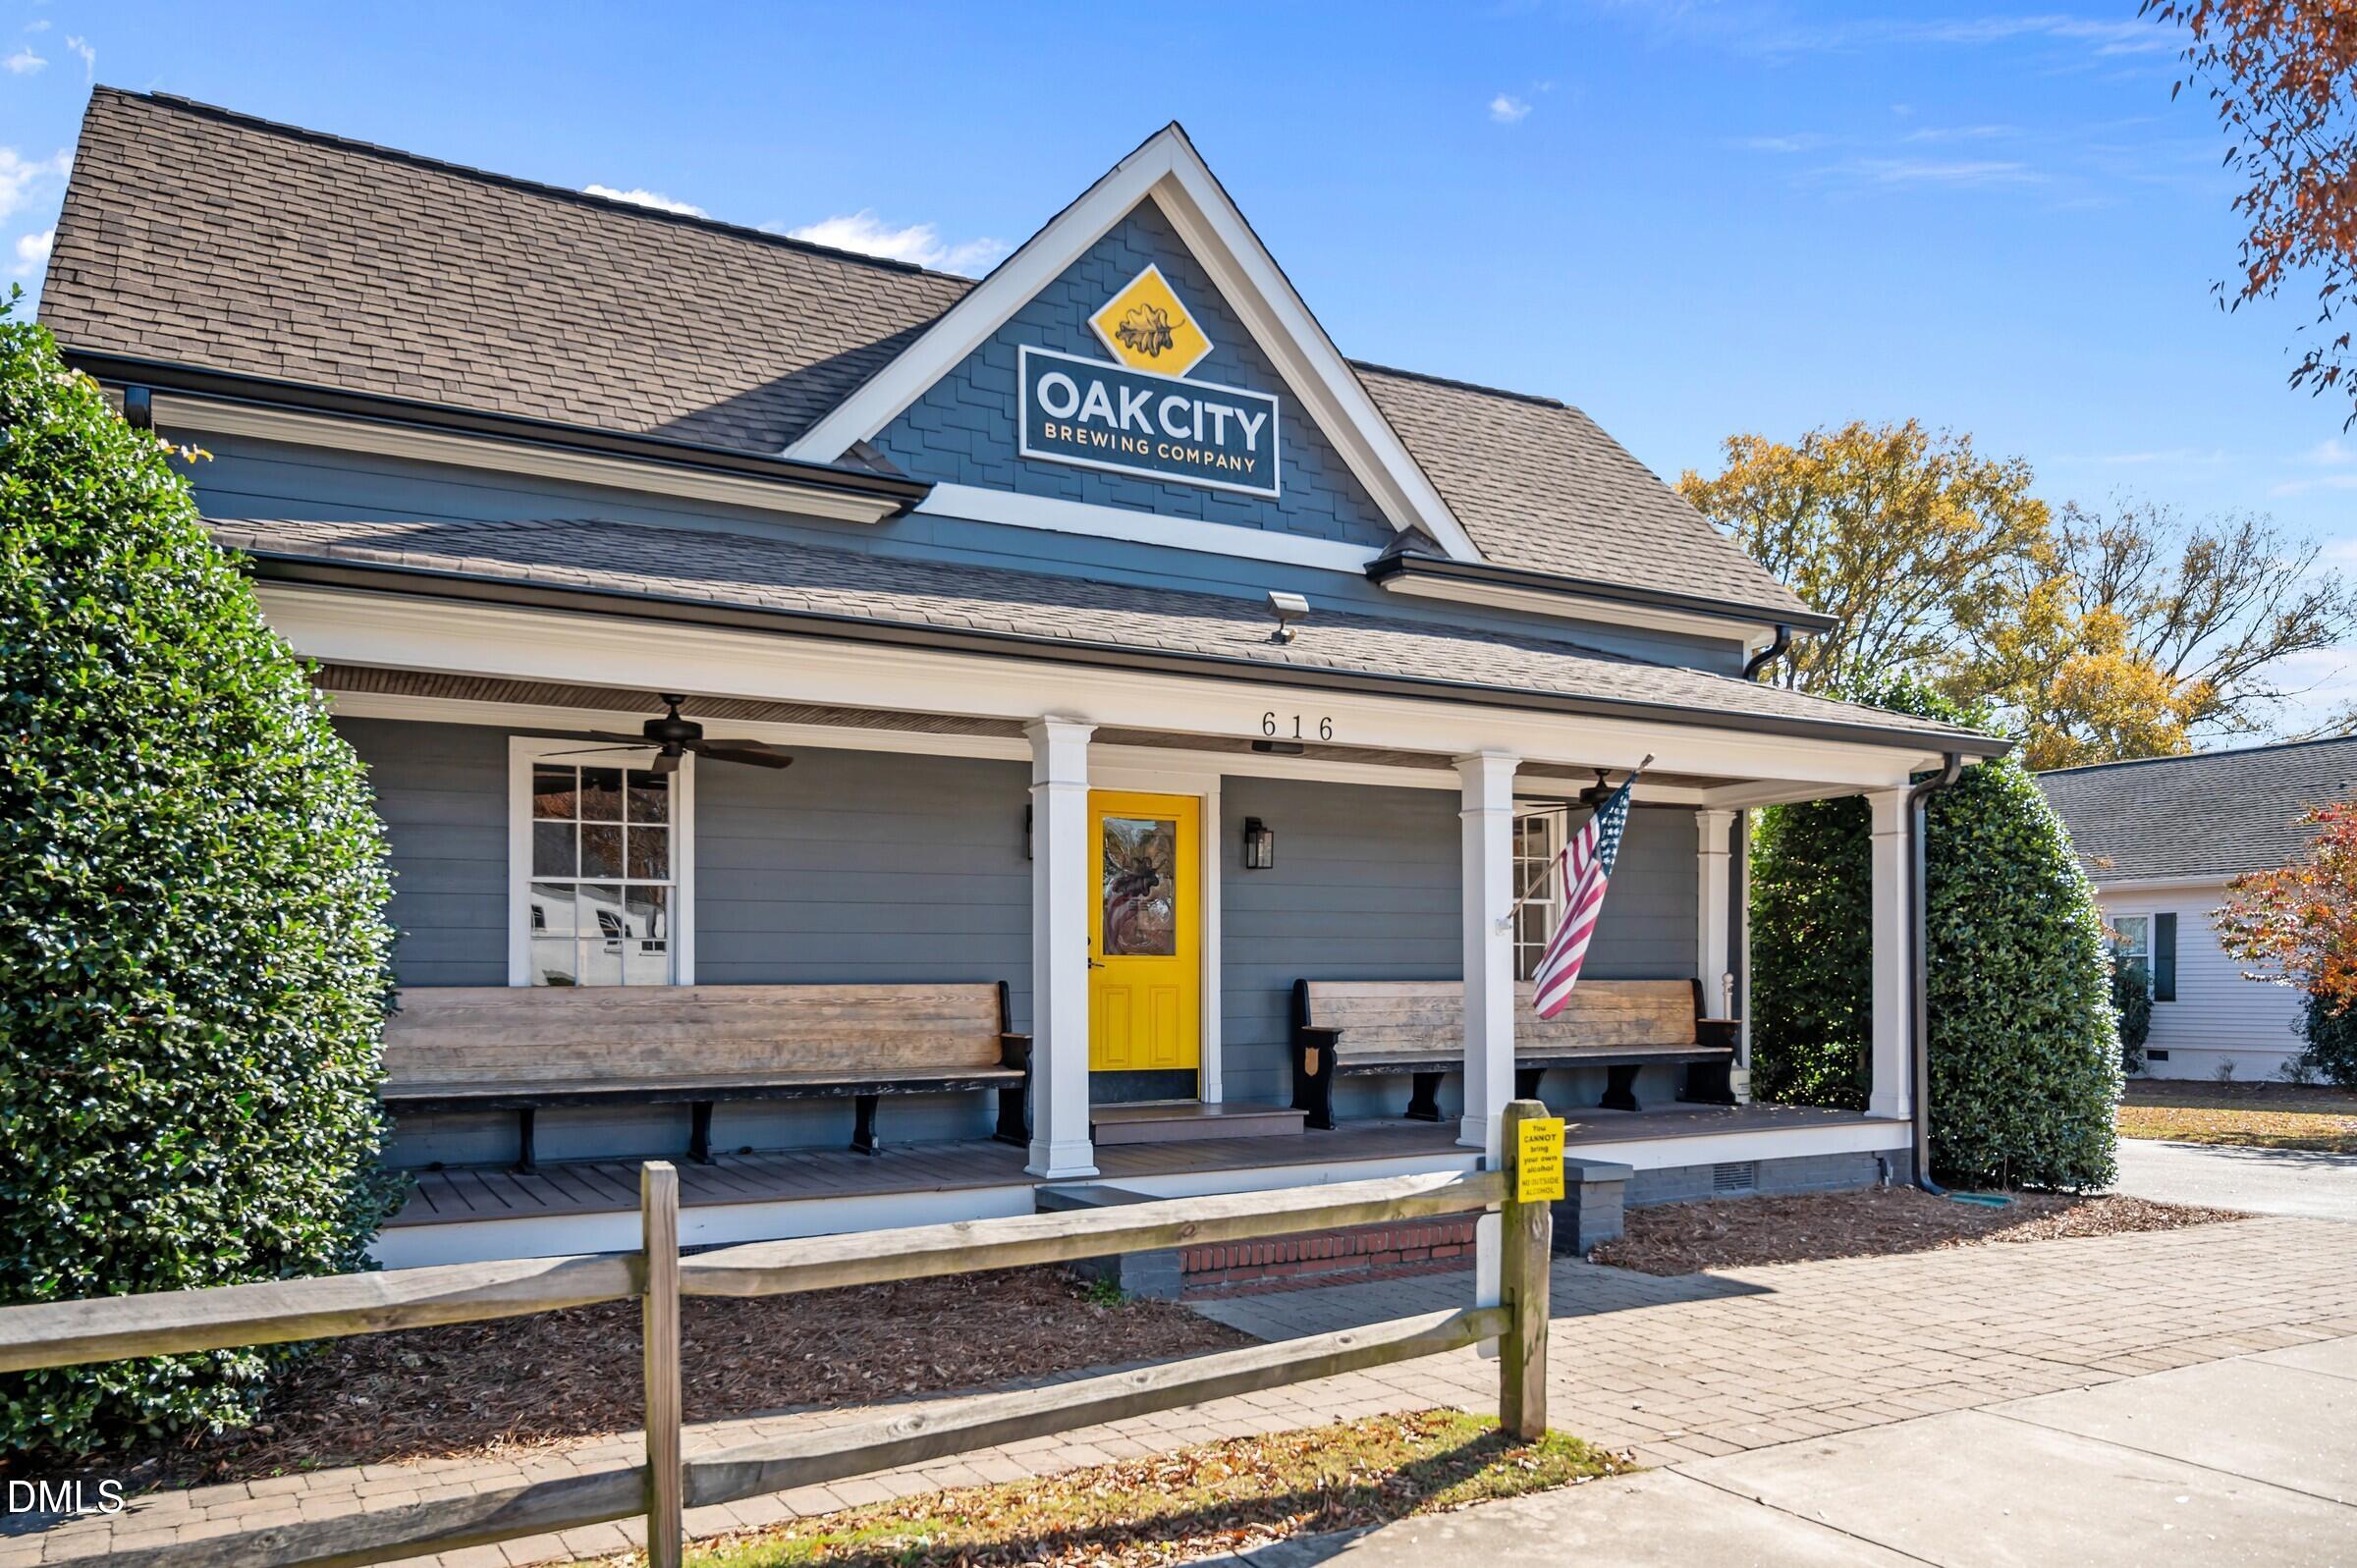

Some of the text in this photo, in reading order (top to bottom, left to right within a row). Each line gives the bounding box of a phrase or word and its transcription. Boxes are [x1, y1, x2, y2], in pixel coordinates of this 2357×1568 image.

[1037, 372, 1267, 452] OAK CITY
[1044, 422, 1256, 473] BREWING COMPANY
[1523, 1134, 1557, 1143] CANNOT
[1524, 1156, 1539, 1164] your
[1531, 1176, 1560, 1185] OUTSIDE
